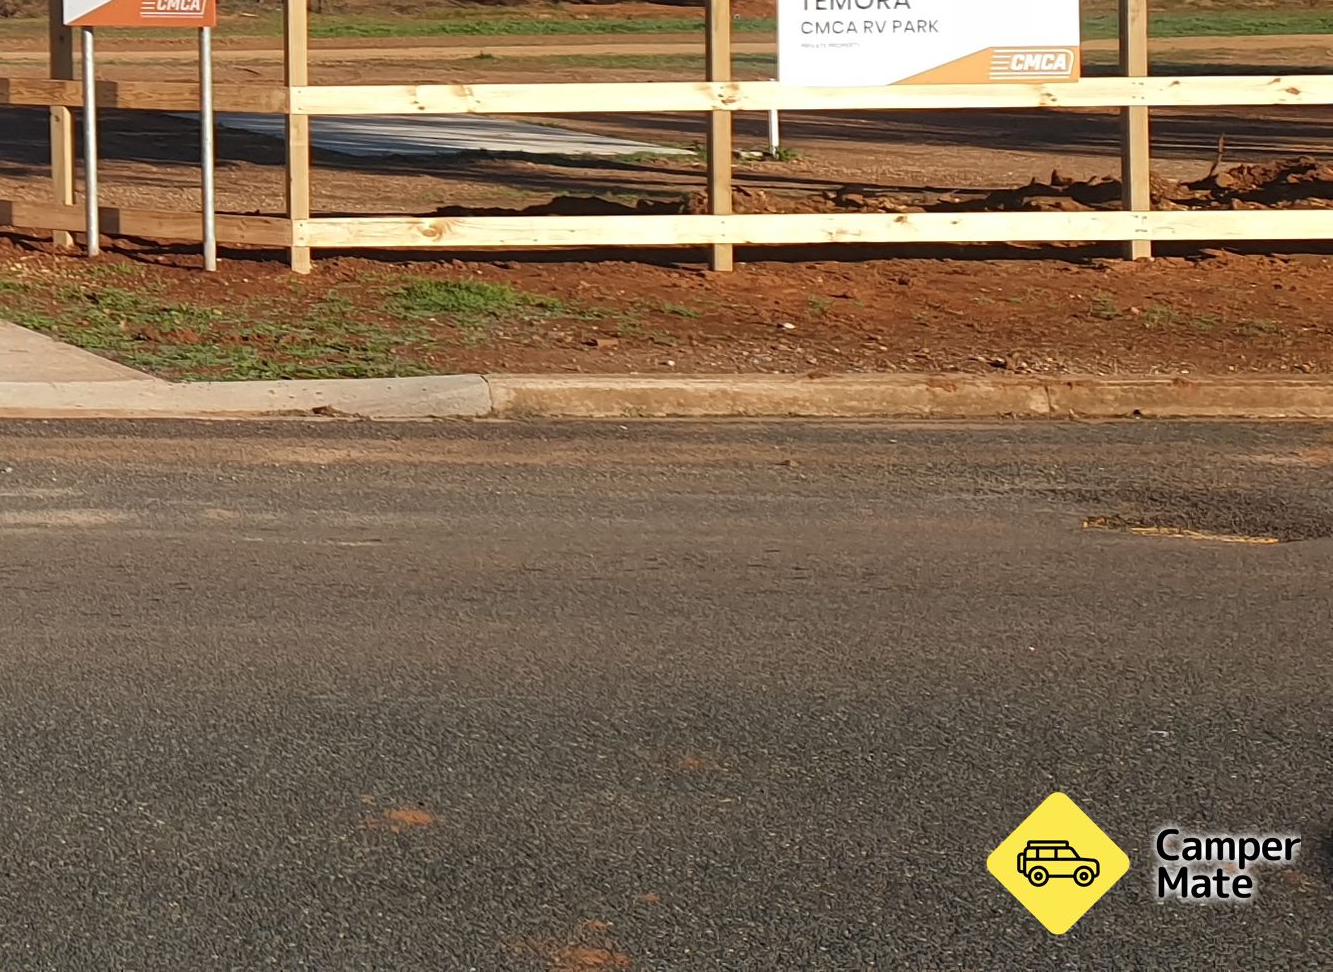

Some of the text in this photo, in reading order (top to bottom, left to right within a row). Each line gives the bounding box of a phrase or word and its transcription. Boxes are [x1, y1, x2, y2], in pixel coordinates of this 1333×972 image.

[801, 19, 939, 34] CMCA RV PARK
[1010, 53, 1068, 72] CMCA
